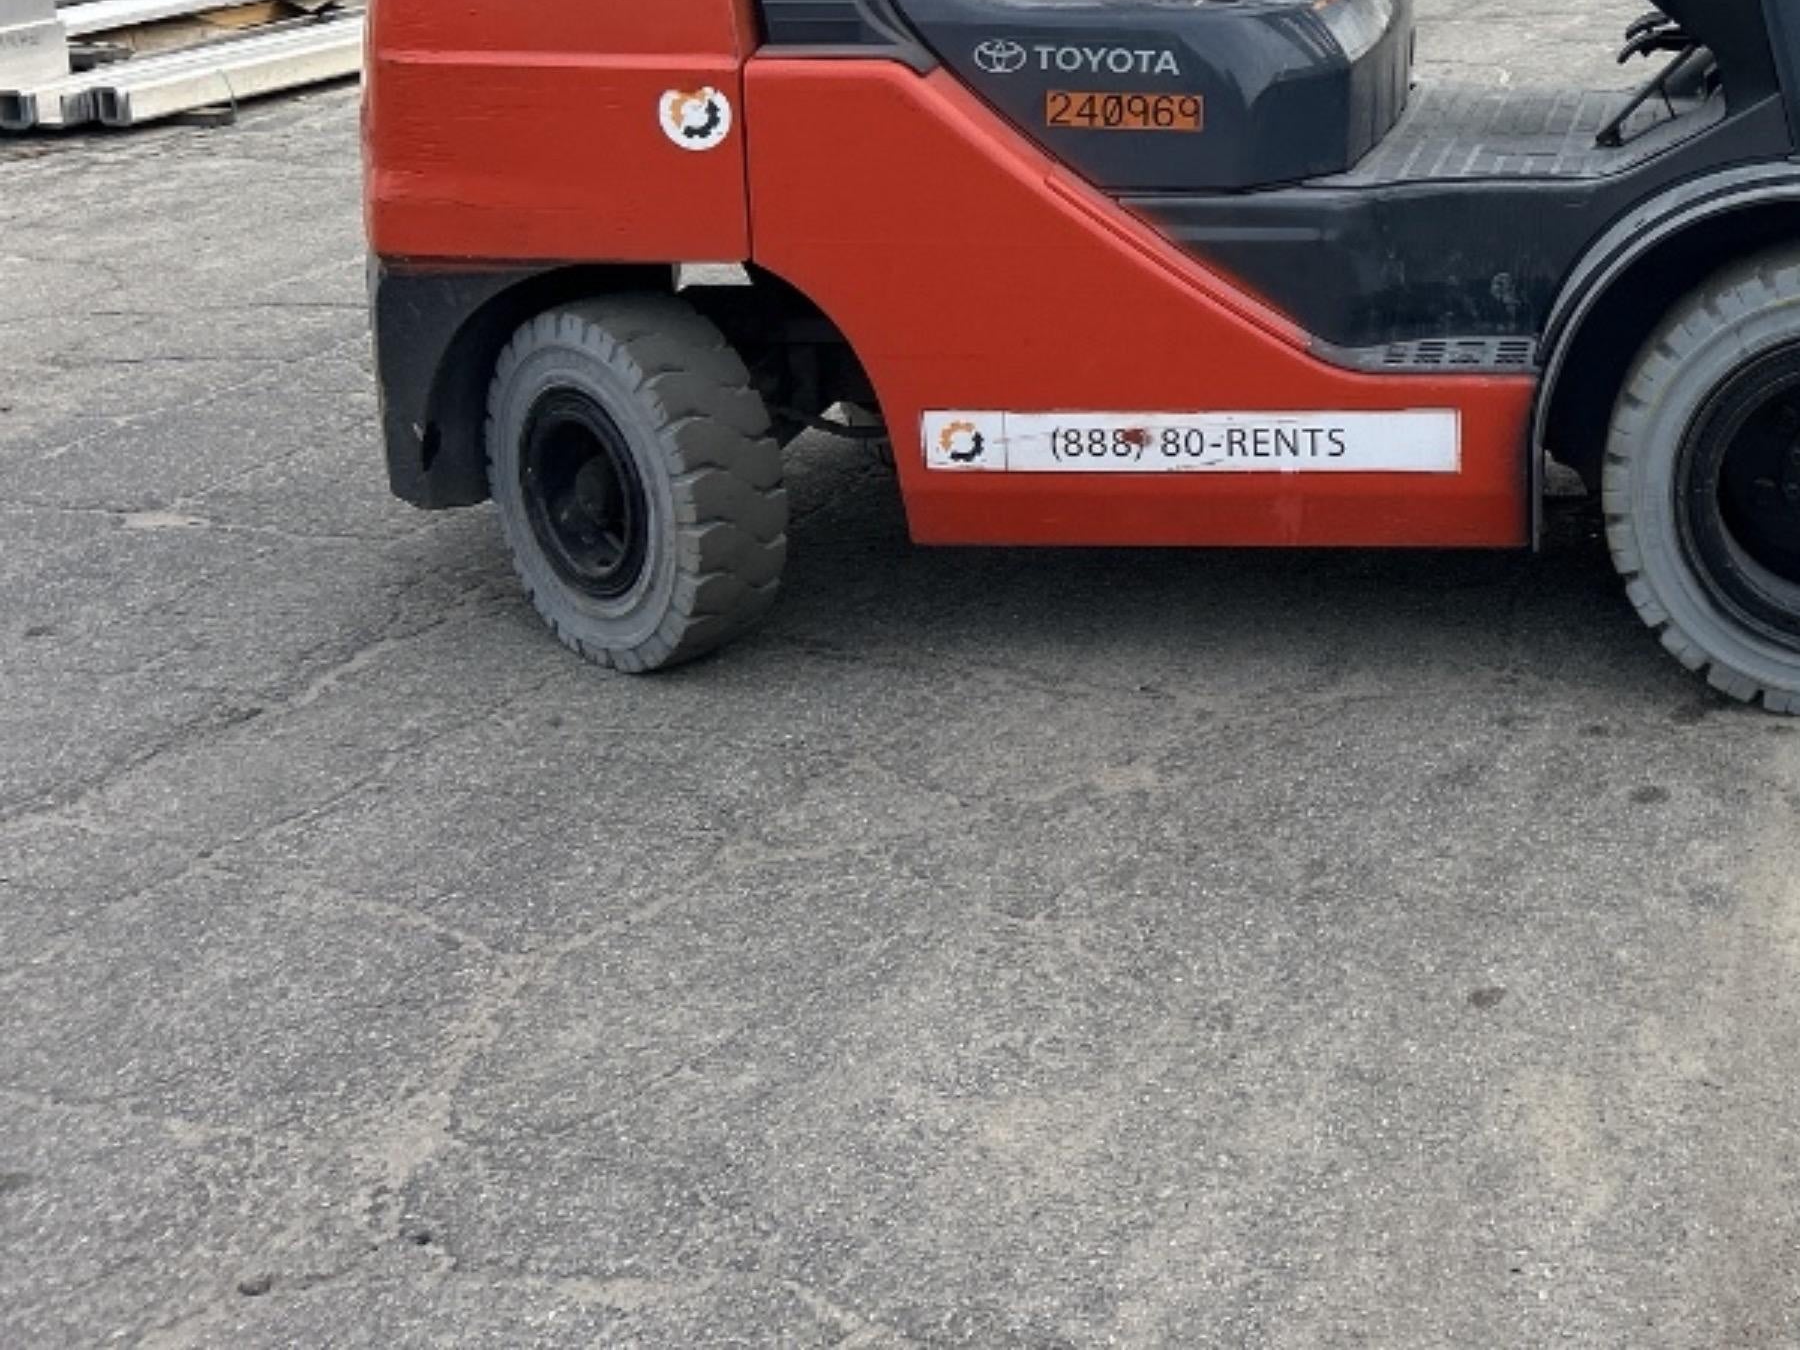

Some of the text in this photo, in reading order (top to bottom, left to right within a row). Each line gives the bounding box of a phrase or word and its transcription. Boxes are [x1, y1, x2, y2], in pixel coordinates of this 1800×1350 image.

[1033, 45, 1180, 75] TOYOTA
[1049, 92, 1200, 128] 240969
[1160, 427, 1346, 457] 80-RENTS
